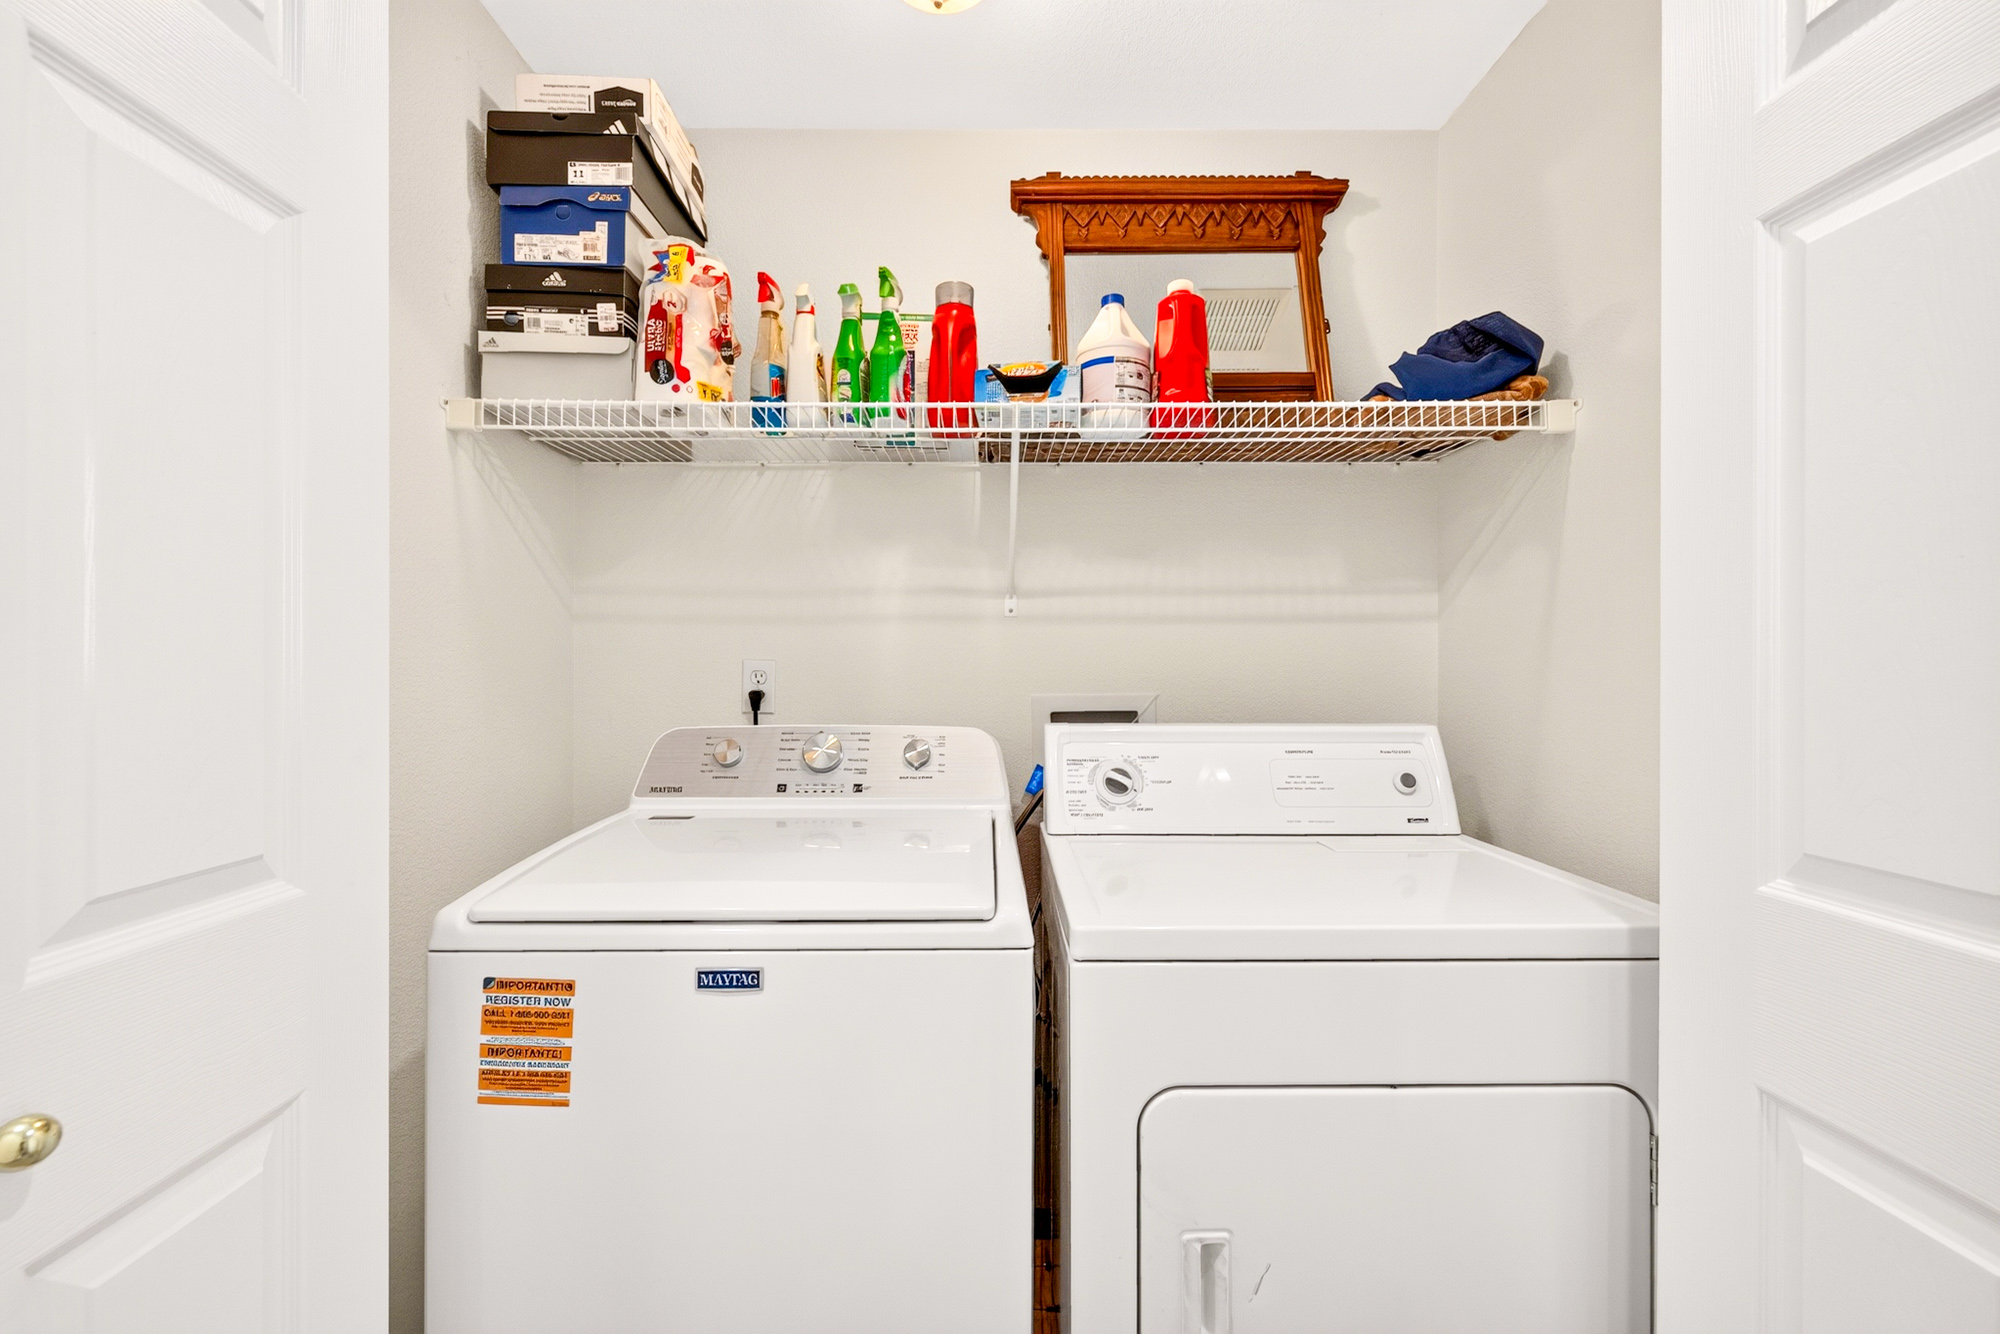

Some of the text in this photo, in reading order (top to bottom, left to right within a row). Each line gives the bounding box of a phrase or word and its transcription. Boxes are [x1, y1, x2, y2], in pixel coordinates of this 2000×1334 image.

[700, 973, 758, 986] MAYTAG
[485, 995, 572, 1007] REGISTER NOW
